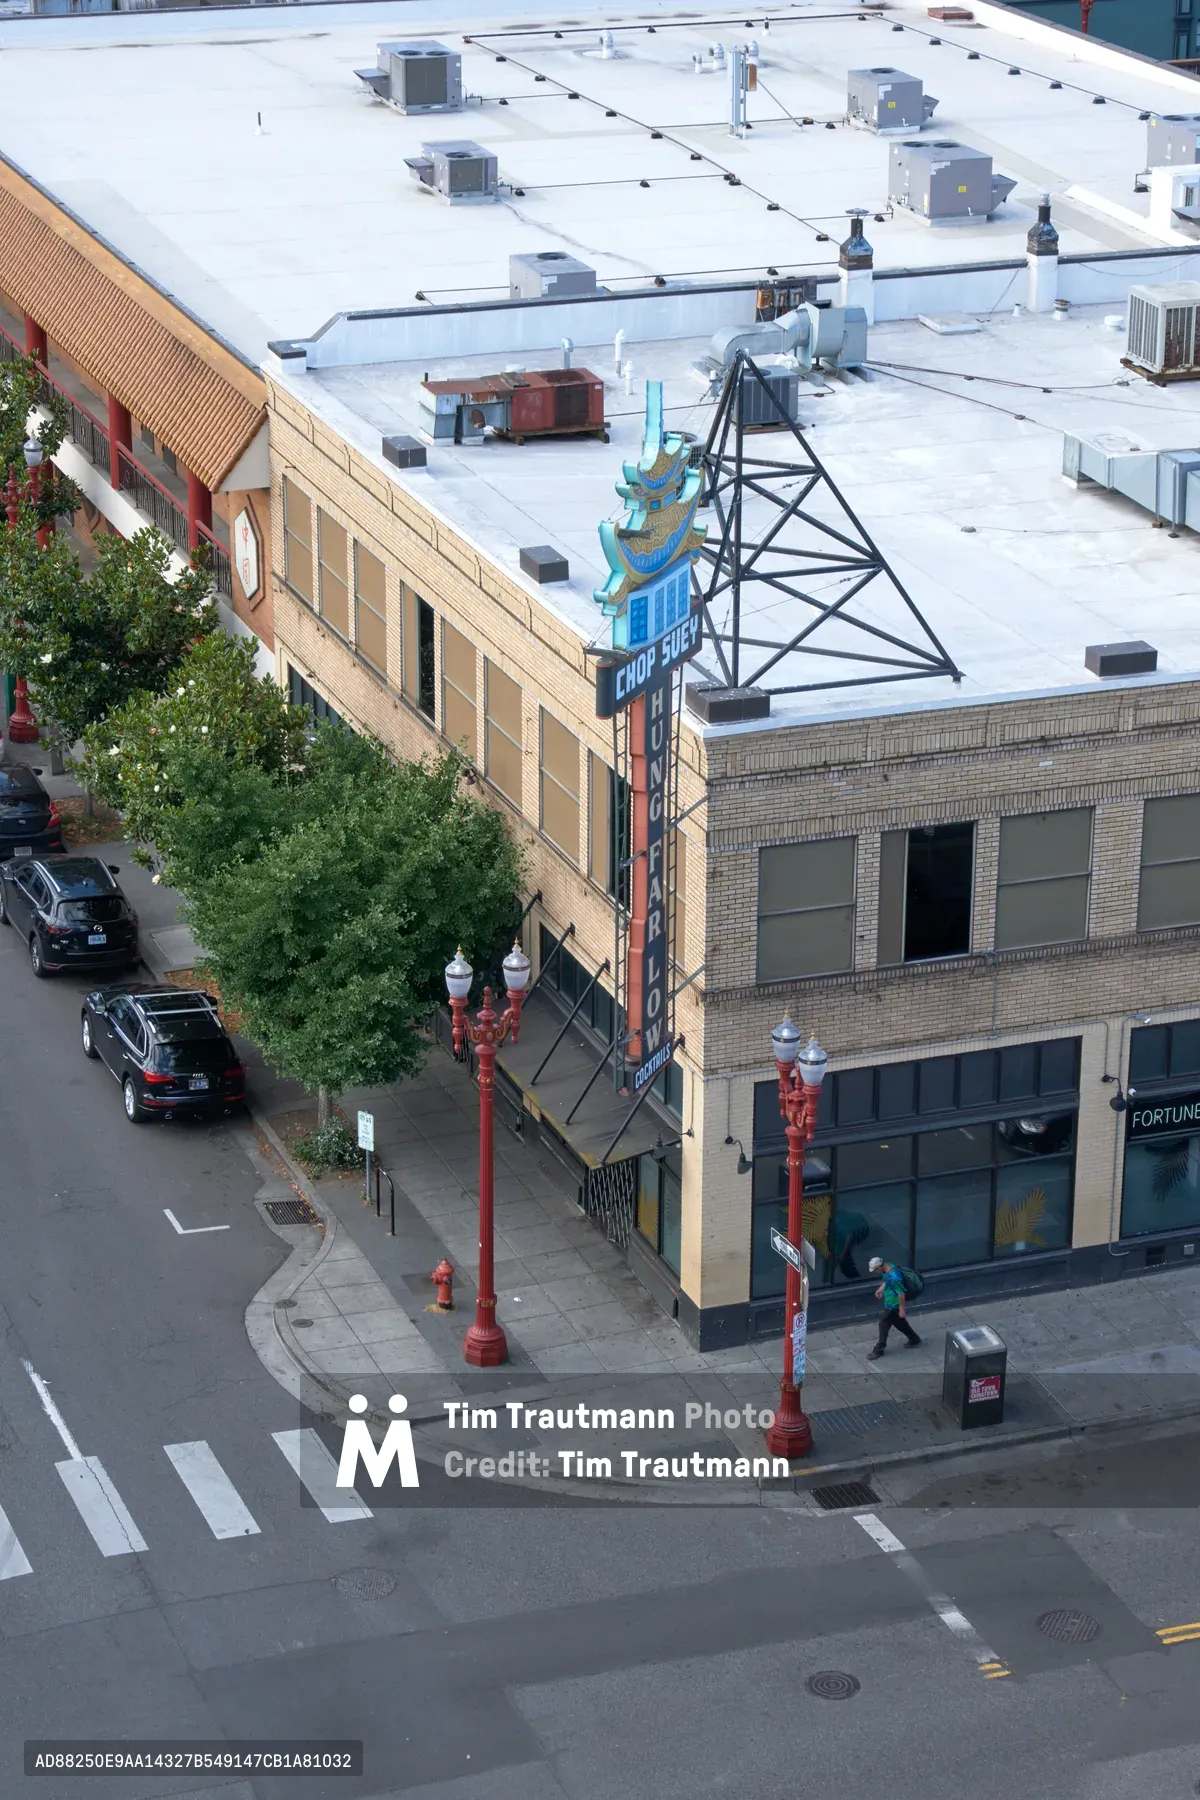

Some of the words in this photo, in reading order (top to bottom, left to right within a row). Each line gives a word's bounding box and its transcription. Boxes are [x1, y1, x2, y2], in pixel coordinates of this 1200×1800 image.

[616, 646, 656, 700] CHOP
[662, 613, 698, 667] SUEY
[649, 687, 664, 822] HUNG
[648, 838, 663, 943] FAR
[646, 955, 664, 1054] LOW
[635, 1042, 671, 1089] COCKTAILS
[1132, 1103, 1200, 1128] FORTUNE
